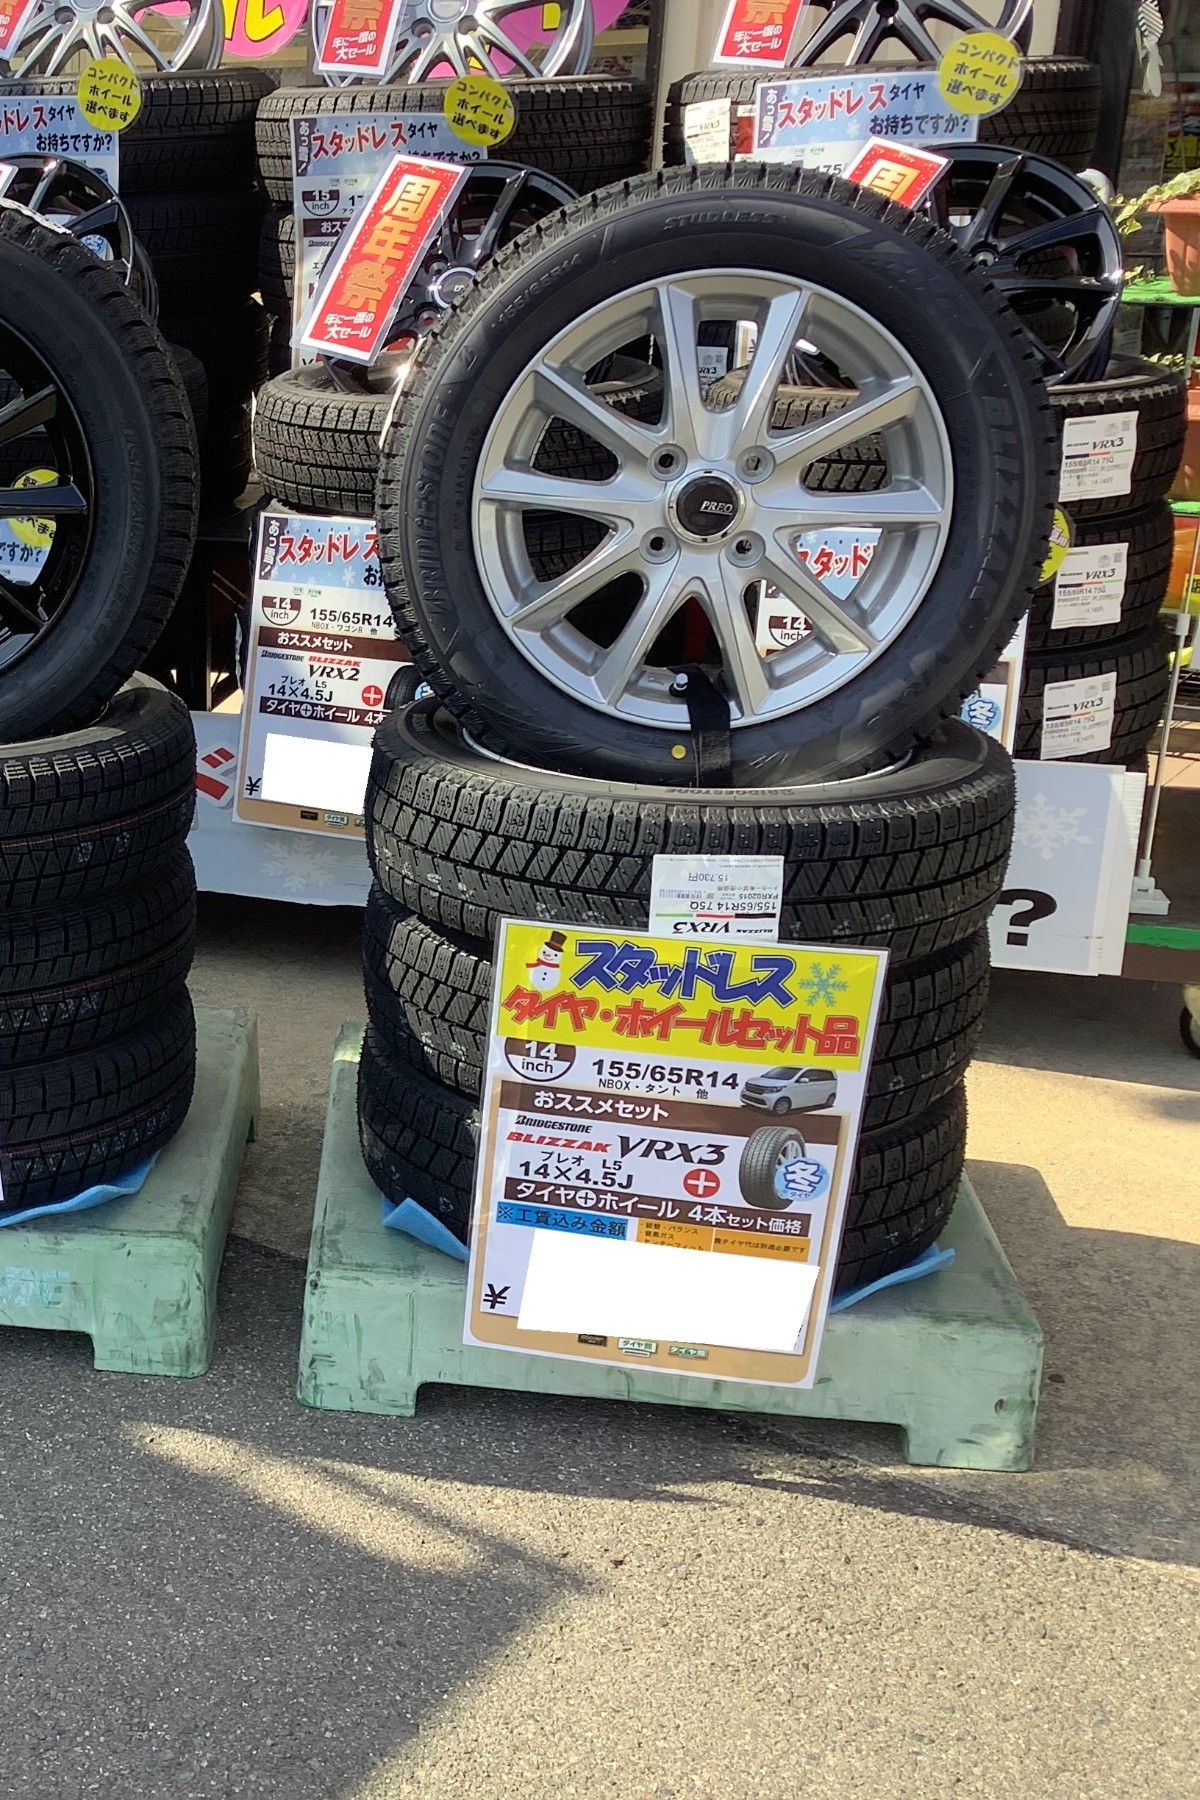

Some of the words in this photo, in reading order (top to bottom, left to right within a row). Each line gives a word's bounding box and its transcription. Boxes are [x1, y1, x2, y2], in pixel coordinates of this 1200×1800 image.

[335, 45, 377, 63] 大セール
[736, 38, 783, 55] 大セール
[954, 41, 1020, 69] コンパクト
[86, 64, 139, 92] コンパクト
[953, 61, 1009, 89] ホイール
[89, 85, 133, 108] ホイール
[456, 80, 514, 110] コンパクト
[945, 78, 1004, 106] 選べます
[85, 100, 131, 123] 選べます
[456, 98, 505, 126] ホイール
[311, 201, 330, 211] inch
[336, 173, 442, 313] 周年祭
[324, 325, 372, 341] 大セール
[1093, 436, 1126, 451] VRX3
[700, 500, 733, 514] PREO
[1086, 567, 1117, 580] VRX3
[273, 597, 292, 610] 14
[270, 609, 289, 620] inch
[309, 608, 395, 628] 155/65R14
[277, 632, 353, 652] おススメセット
[308, 655, 362, 668] BLIZZAK
[308, 664, 361, 682] VRX2
[689, 900, 713, 911] 75Q
[717, 901, 777, 911] 155/65R14
[672, 921, 731, 935] VRX3
[571, 939, 798, 1009] スタッドレス
[525, 1040, 558, 1061] 14
[520, 1057, 554, 1075] inch
[592, 1059, 739, 1091] 155/65R14
[696, 1087, 709, 1100] 他
[533, 1090, 669, 1121] おススメセット
[514, 1114, 593, 1134] BRIDGESTONE
[506, 1131, 613, 1154] BLIZZAK
[616, 1134, 730, 1166] VRX3
[540, 1150, 585, 1167] プレオ
[601, 1159, 623, 1173] L5
[785, 1159, 824, 1194] 冬
[688, 1204, 803, 1235] 4本セット価格
